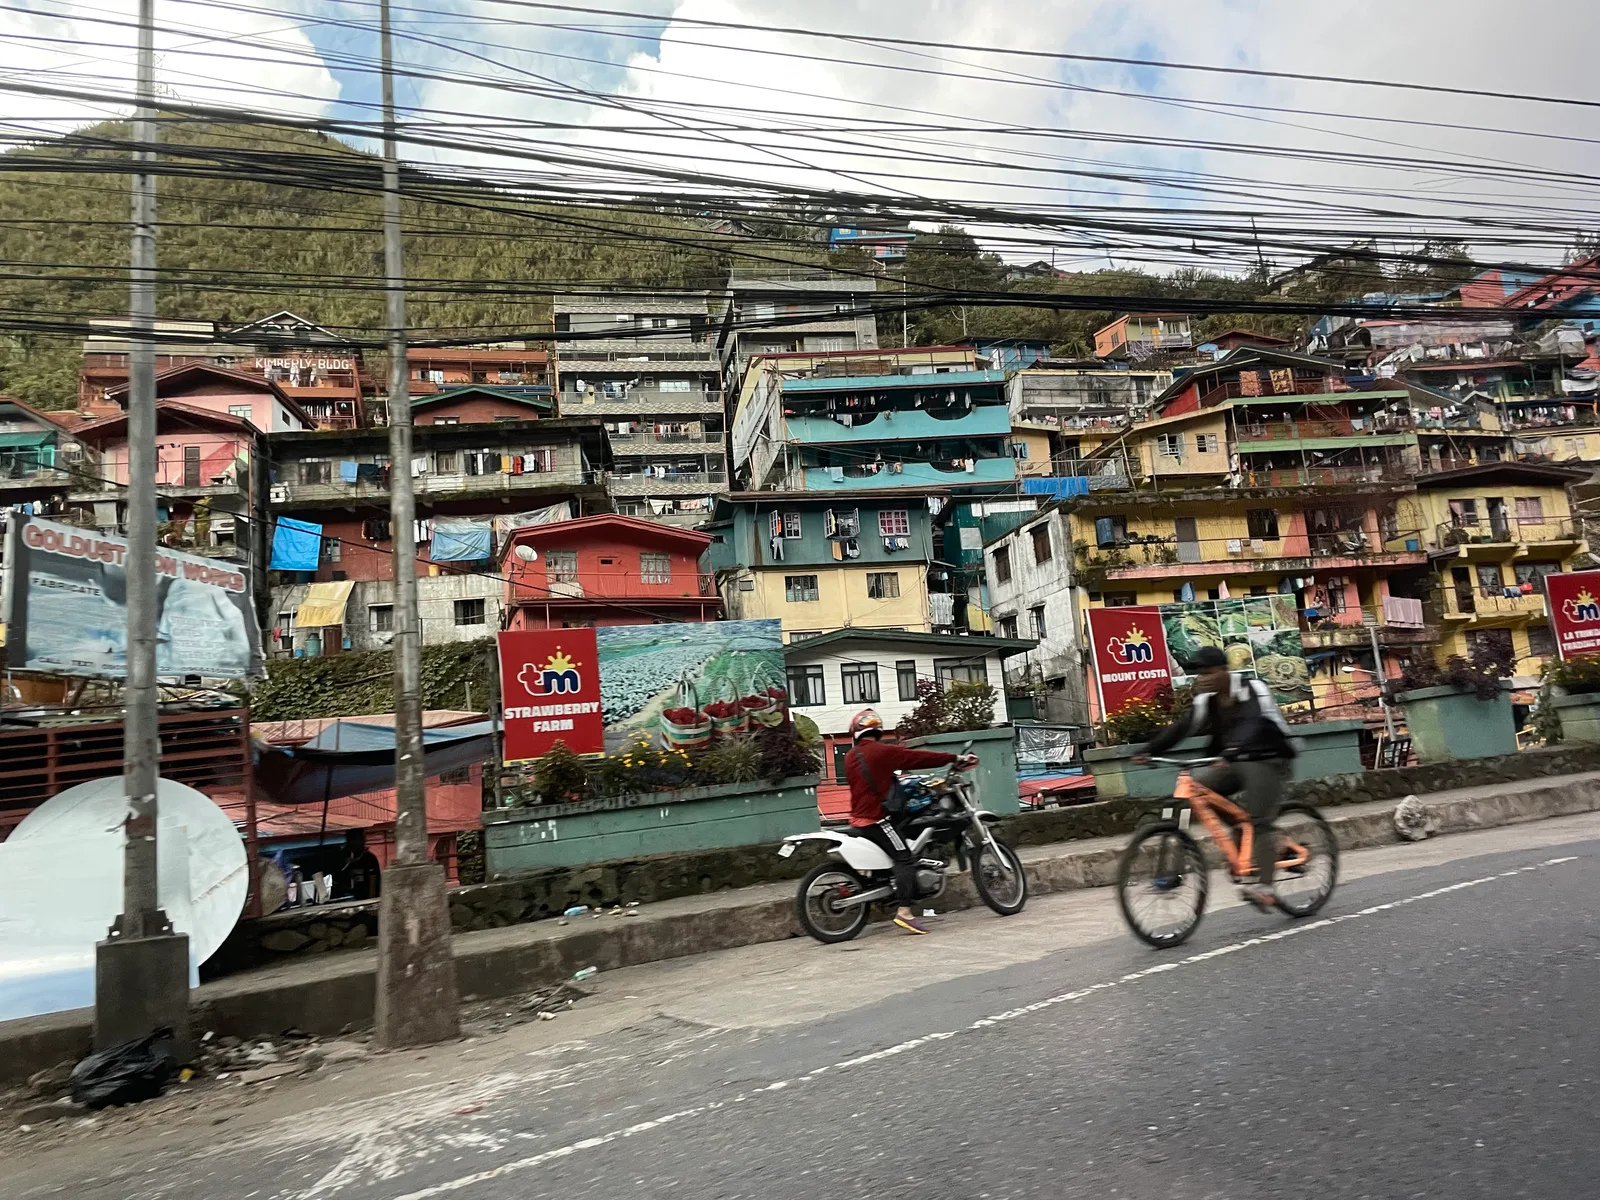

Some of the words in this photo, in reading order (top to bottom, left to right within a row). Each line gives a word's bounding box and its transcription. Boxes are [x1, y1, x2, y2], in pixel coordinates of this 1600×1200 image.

[24, 524, 127, 566] GOLDUST
[183, 560, 245, 592] WORKS
[1107, 637, 1153, 664] tm
[517, 663, 581, 696] tm
[1102, 671, 1137, 683] MOUNT
[1138, 669, 1168, 679] COSTA
[504, 702, 599, 719] STRAWBERRY
[533, 719, 574, 733] FARM
